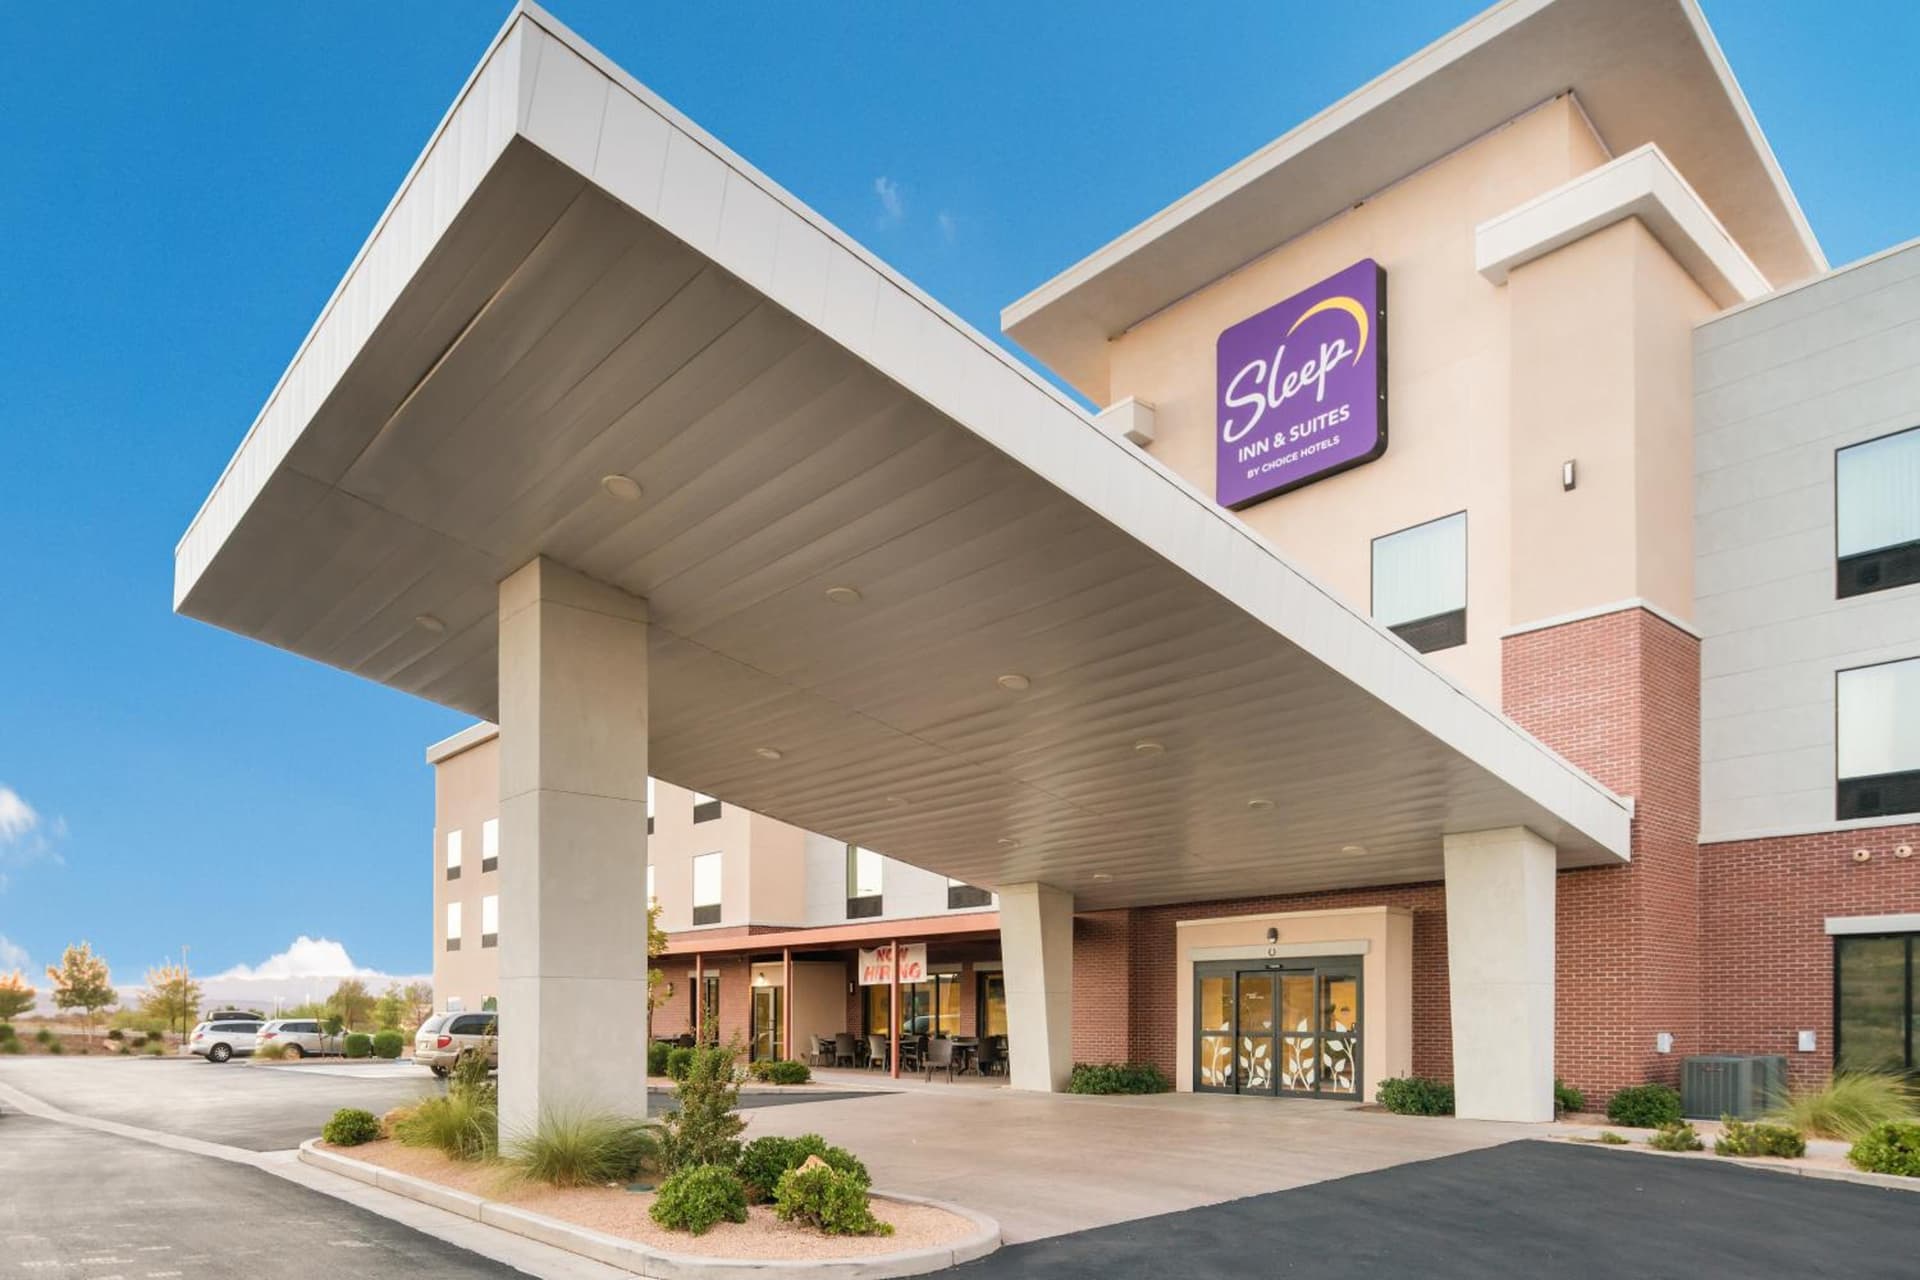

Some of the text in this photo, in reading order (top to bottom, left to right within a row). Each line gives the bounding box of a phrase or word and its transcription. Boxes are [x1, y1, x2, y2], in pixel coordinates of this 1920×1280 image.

[1223, 338, 1353, 443] Sleep
[1238, 404, 1350, 463] INN & SUITES
[1247, 435, 1341, 479] BY CHOICE HOTELS
[863, 962, 921, 981] HIRNG
